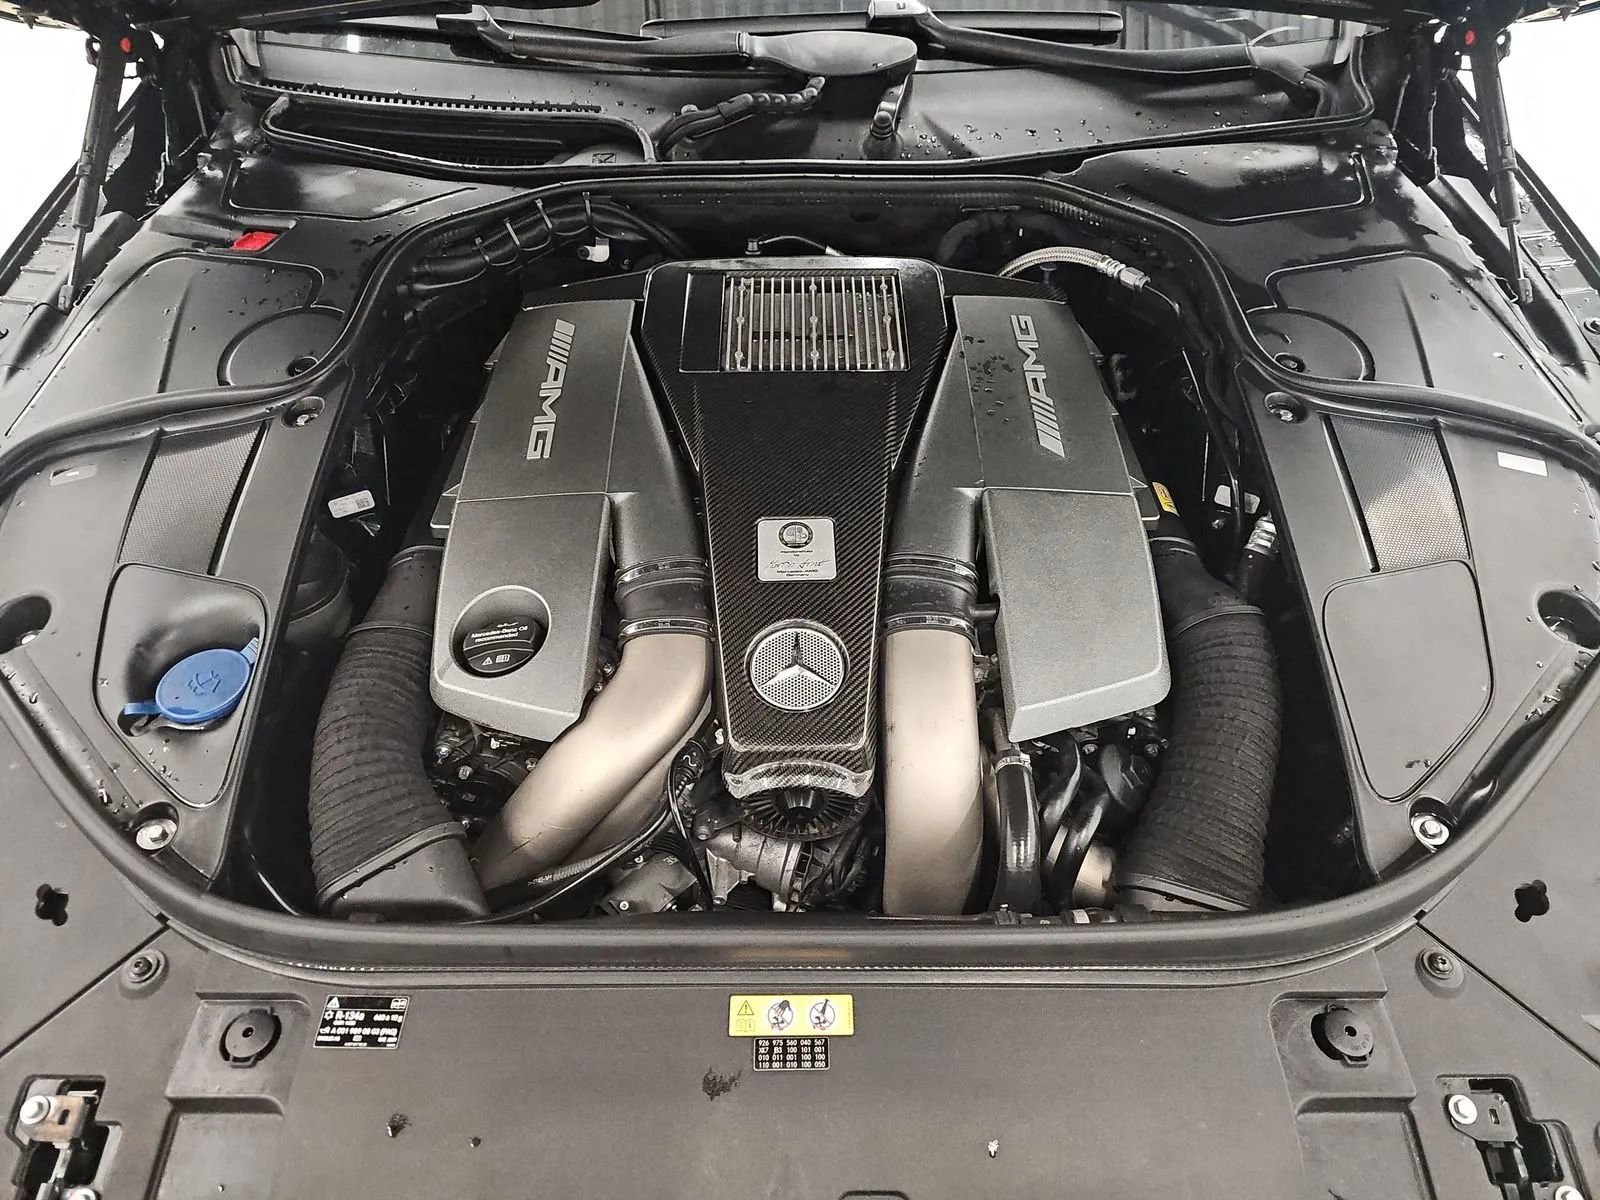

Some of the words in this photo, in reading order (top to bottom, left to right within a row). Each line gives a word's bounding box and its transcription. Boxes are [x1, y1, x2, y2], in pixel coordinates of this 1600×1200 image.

[471, 628, 518, 638] Mercedes-Benz
[474, 632, 519, 643] recommended
[814, 1038, 825, 1046] 567
[758, 1061, 770, 1069] 110
